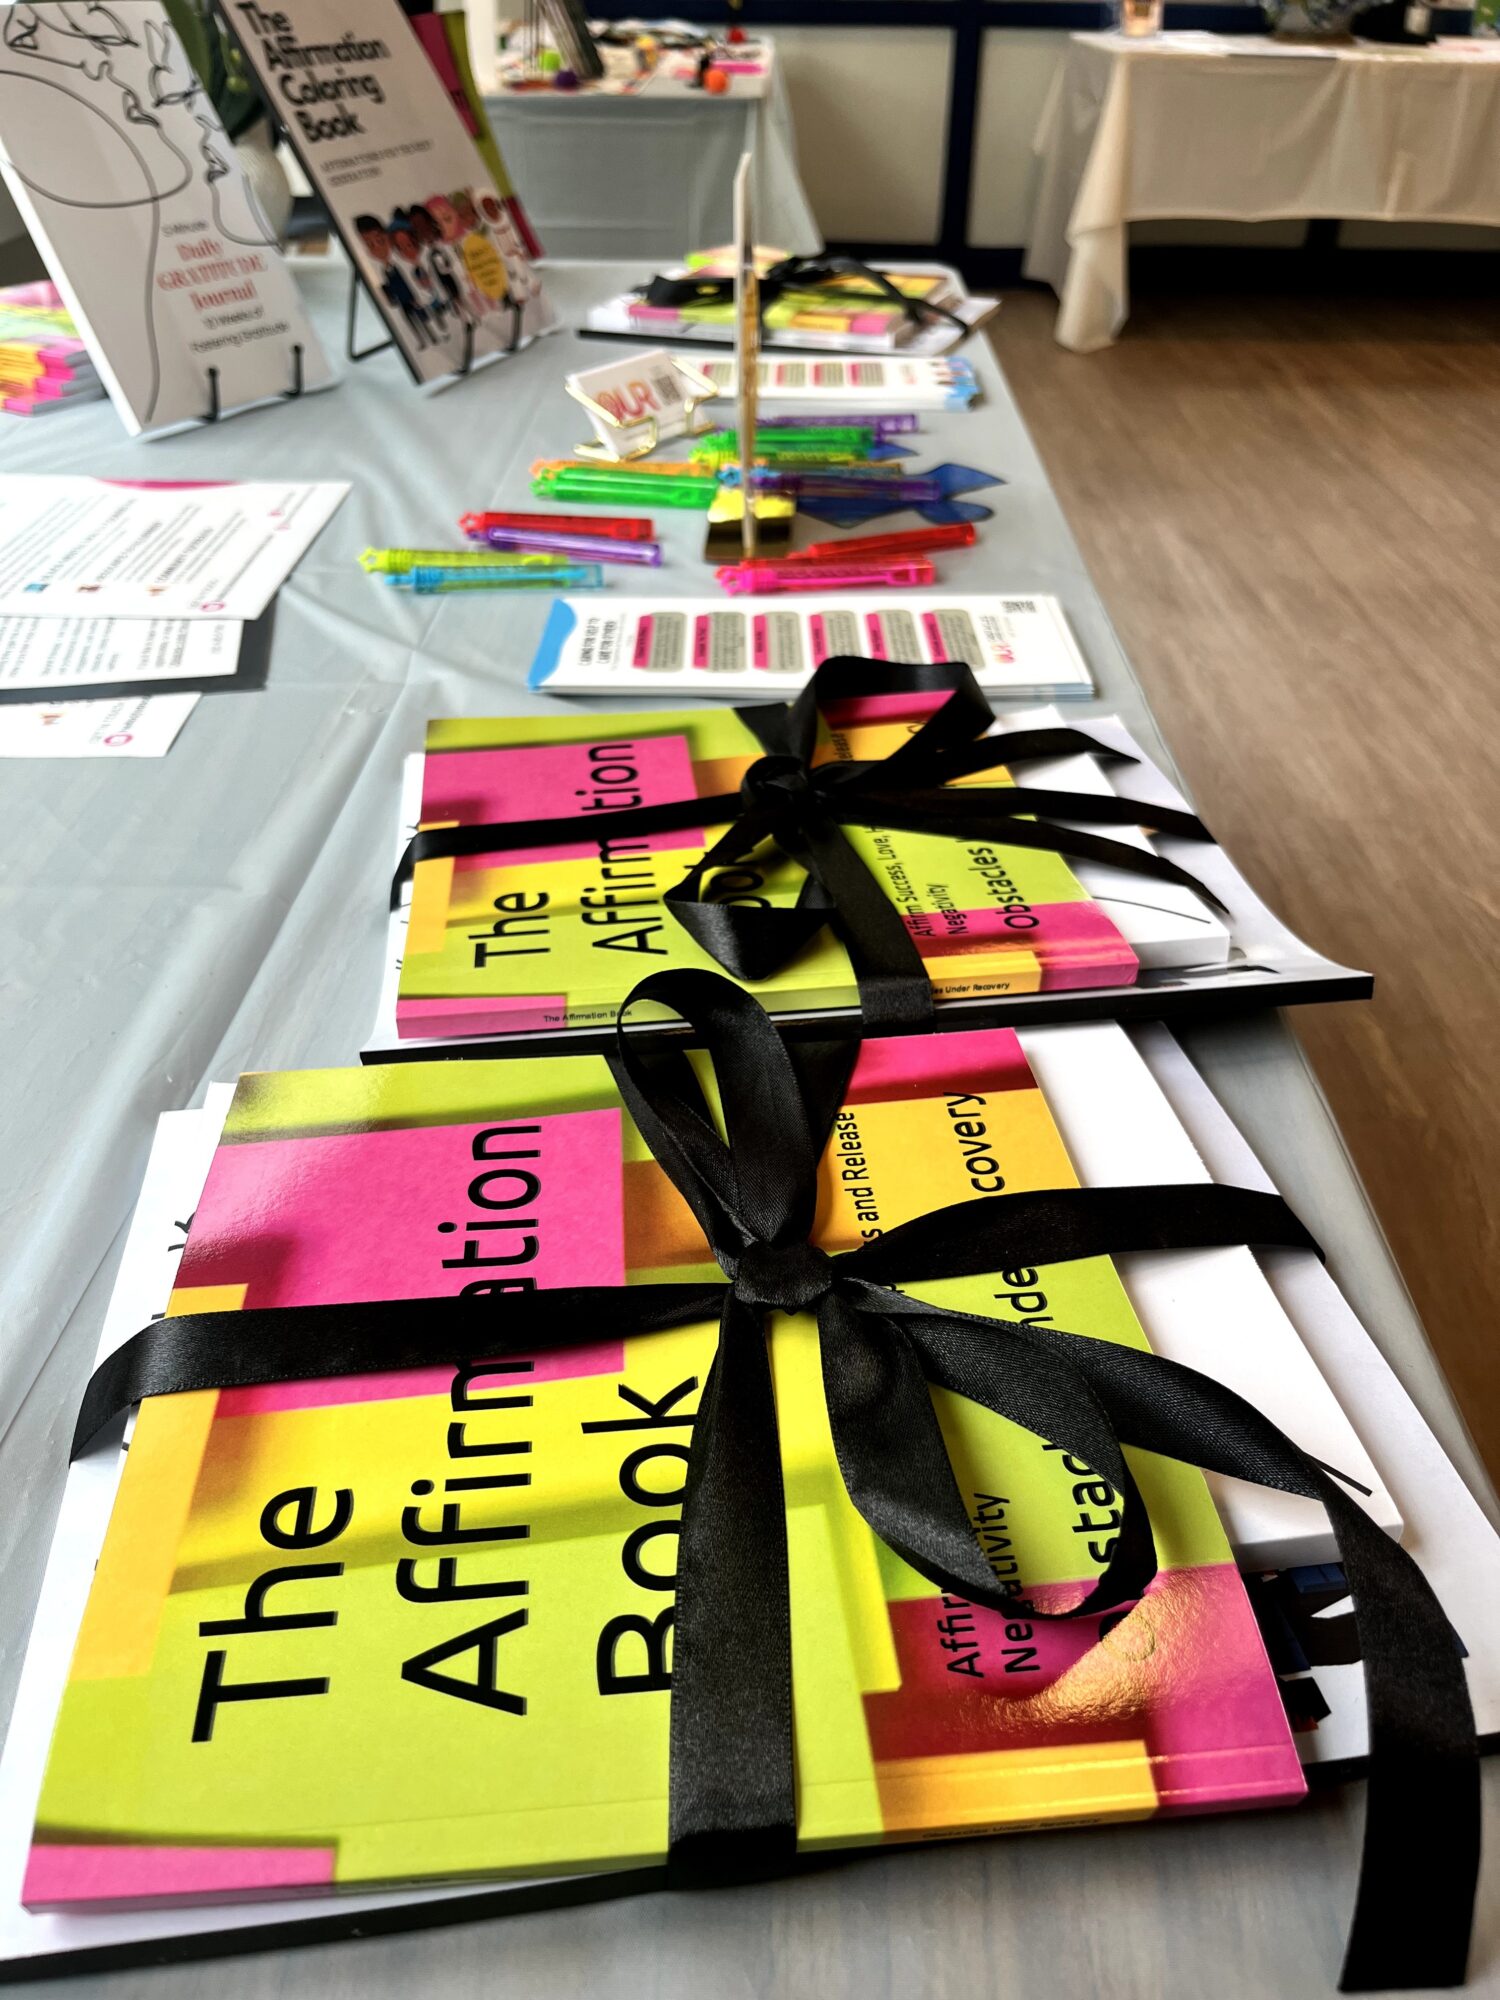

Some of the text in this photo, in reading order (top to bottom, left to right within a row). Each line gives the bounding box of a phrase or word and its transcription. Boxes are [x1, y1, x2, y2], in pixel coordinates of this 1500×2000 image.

[236, 1, 292, 36] The
[262, 31, 392, 71] Affirmation
[279, 69, 386, 105] Coloring
[294, 103, 367, 144] Book
[575, 743, 668, 955] Affirmtion
[873, 835, 896, 860] Love,
[886, 862, 918, 903] Success,
[968, 847, 1040, 929] Obstacles
[468, 891, 552, 968] The
[905, 904, 936, 937] Affirm
[927, 883, 969, 936] Negativity
[945, 985, 970, 994] Under
[973, 982, 1010, 991] Recovery
[543, 1014, 560, 1022] The
[562, 1011, 608, 1021] Affirmation
[836, 1112, 869, 1180] Release
[943, 1092, 1006, 1192] covery
[845, 1187, 880, 1222] and
[581, 1376, 699, 1696] Book
[974, 1493, 1041, 1673] Netivity
[190, 1485, 354, 1743] The
[937, 1588, 984, 1678] Affir
